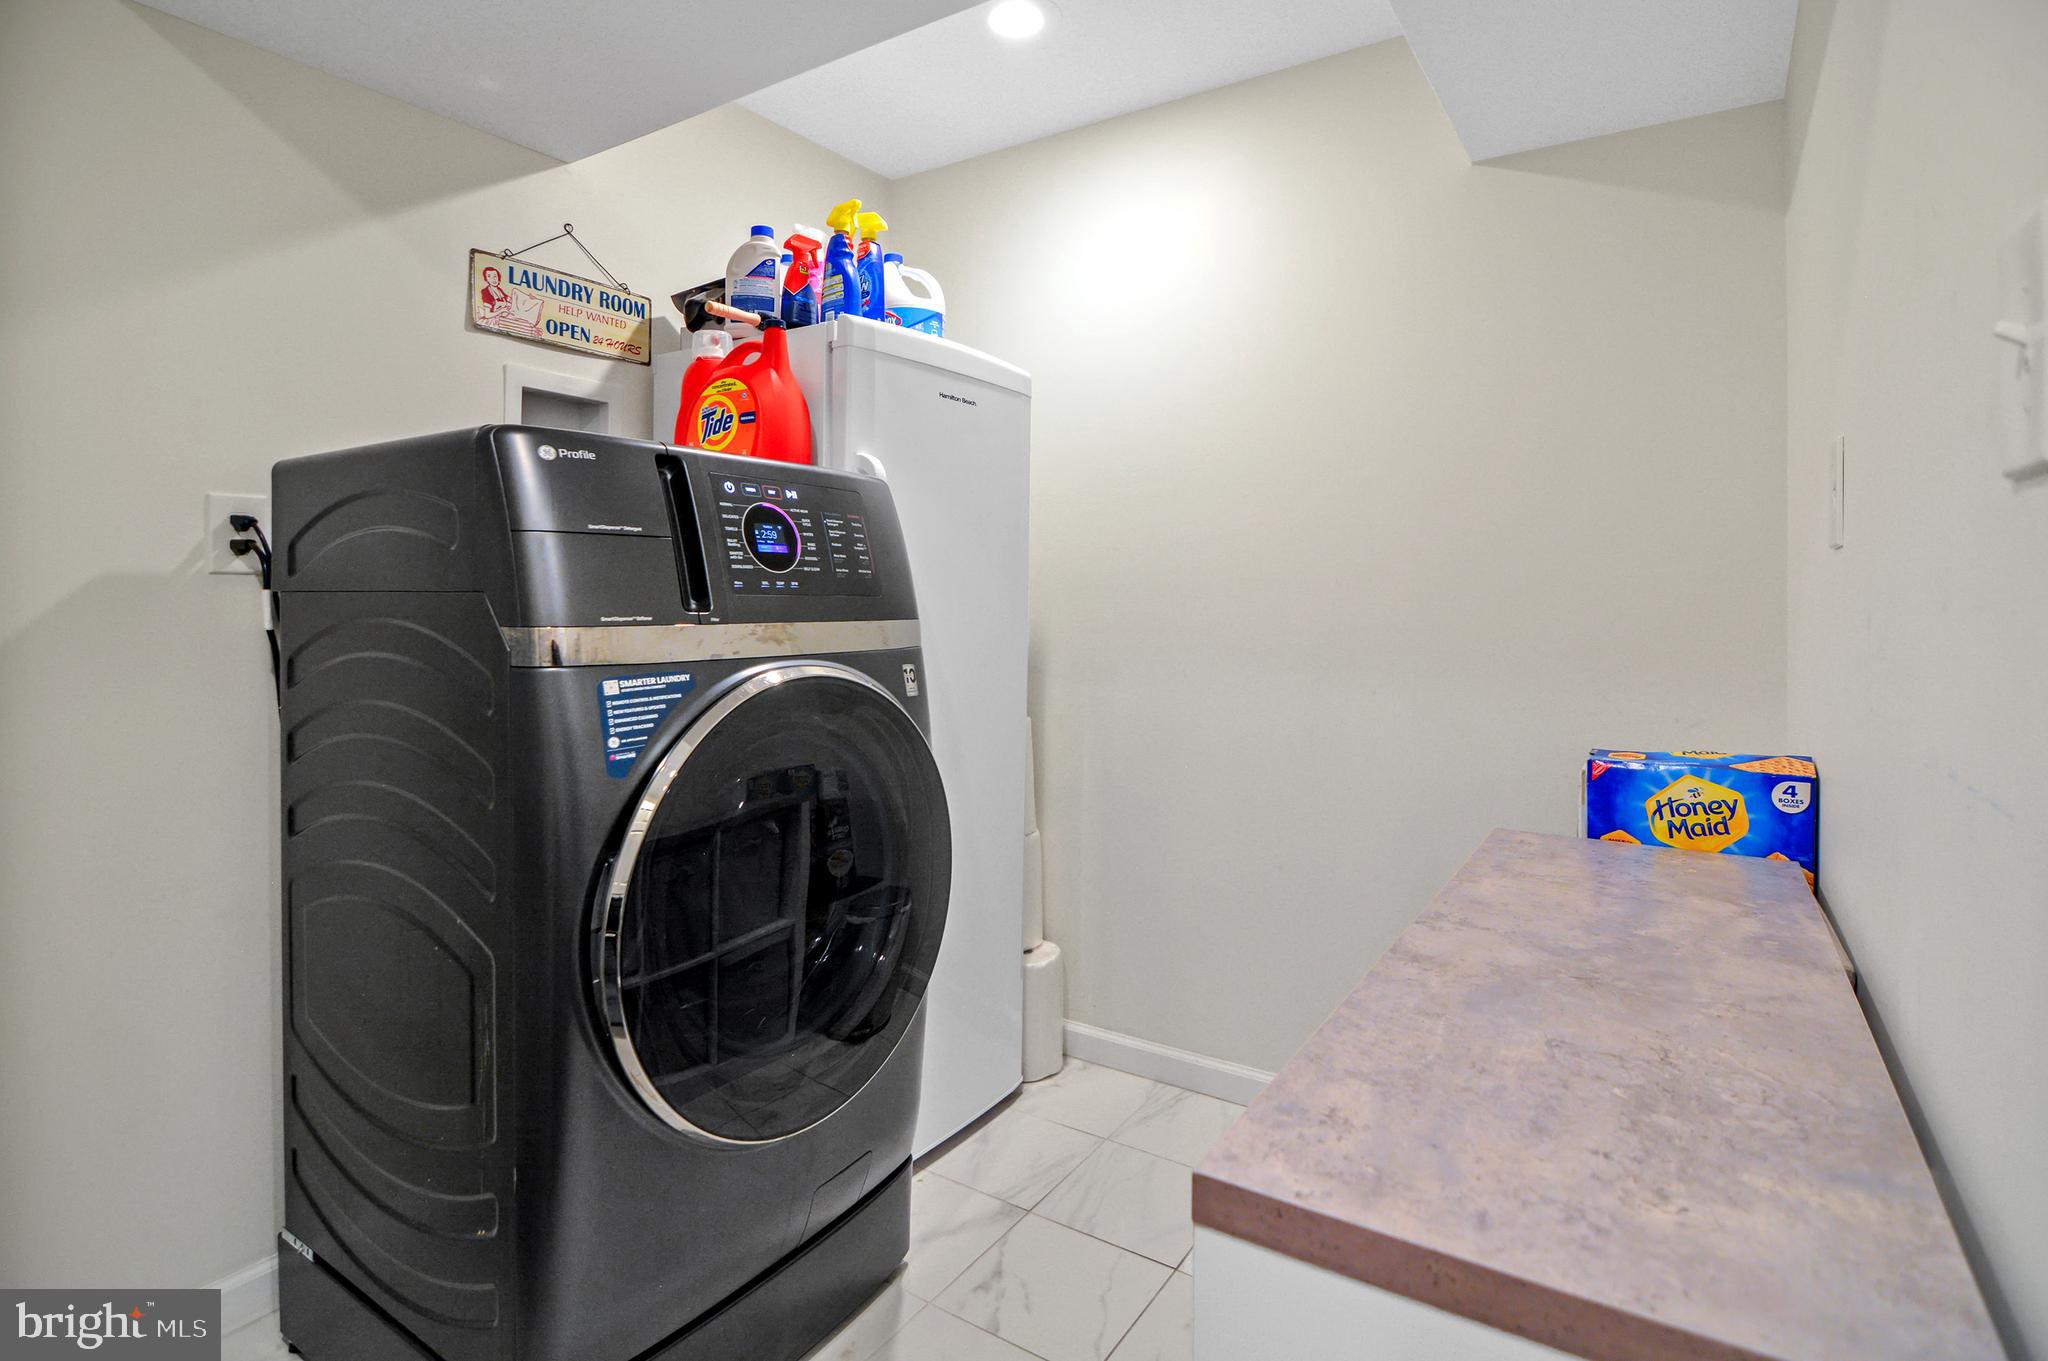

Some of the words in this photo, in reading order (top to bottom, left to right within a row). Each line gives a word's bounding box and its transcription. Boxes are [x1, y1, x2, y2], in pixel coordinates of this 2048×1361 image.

[508, 265, 594, 305] LAUNDRY
[599, 291, 646, 320] ROOM
[558, 304, 583, 317] HELP
[586, 311, 628, 330] WANTED
[545, 319, 591, 343] OPEN
[592, 335, 604, 345] 24
[604, 337, 642, 356] HOURS
[938, 391, 962, 403] Hamilton
[962, 397, 977, 406] Beach
[701, 407, 735, 445] Tide
[558, 448, 596, 460] Profile
[760, 530, 778, 540] 2:59
[619, 677, 656, 688] SMARTER
[656, 674, 690, 684] LAUNDRY
[1782, 784, 1799, 798] 4
[1652, 796, 1739, 822] Honey
[1778, 798, 1805, 806] BOXES
[1667, 814, 1731, 840] Maid
